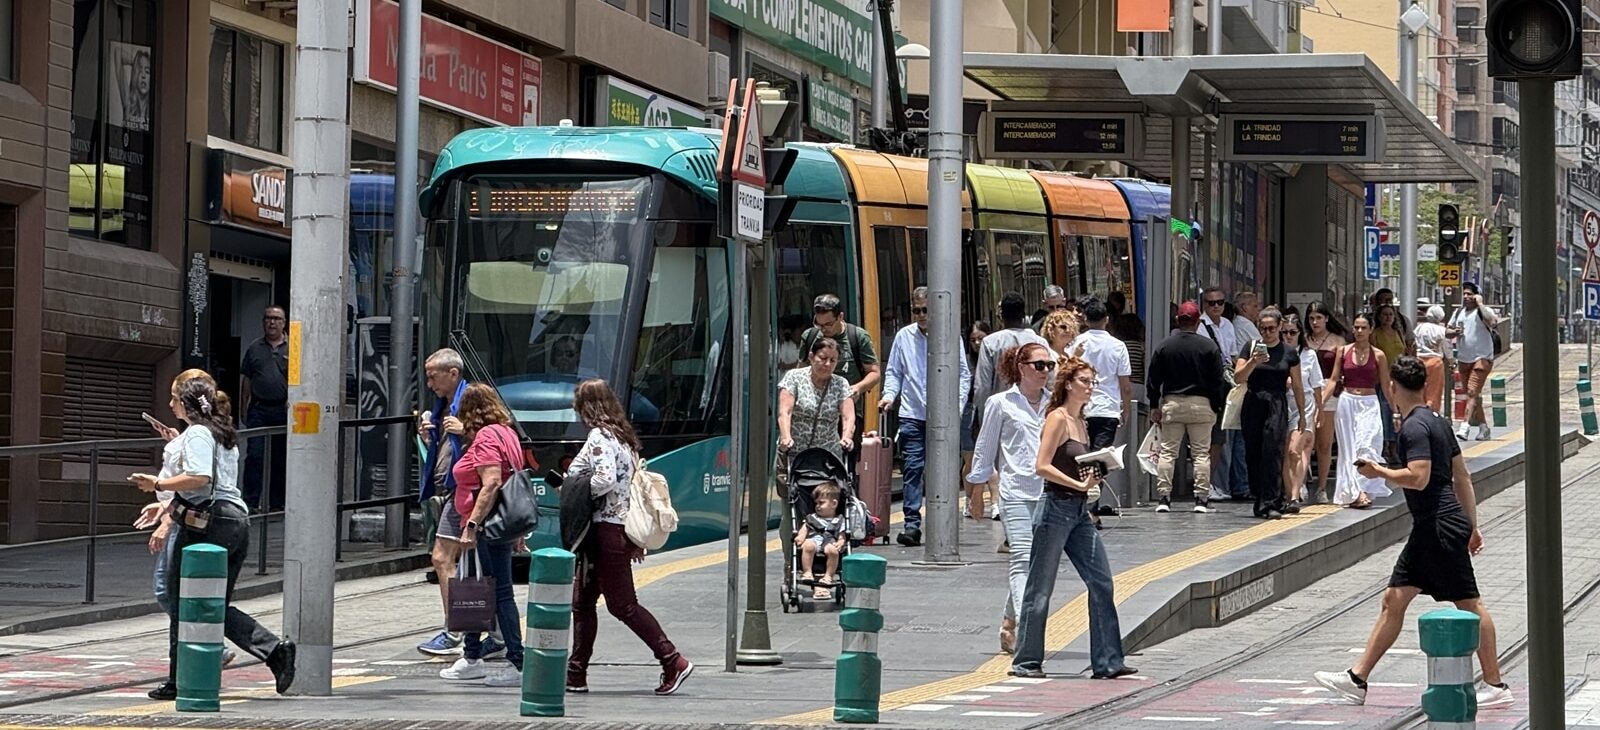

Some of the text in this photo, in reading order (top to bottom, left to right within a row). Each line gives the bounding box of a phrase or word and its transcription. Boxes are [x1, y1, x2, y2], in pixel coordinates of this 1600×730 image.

[762, 0, 852, 64] COMPLEMENTOS
[448, 46, 487, 99] Paris
[739, 191, 764, 212] PRIORIDAD
[1368, 231, 1378, 258] P
[1440, 269, 1458, 281] 25
[1445, 287, 1452, 296] C
[1587, 286, 1598, 316] P
